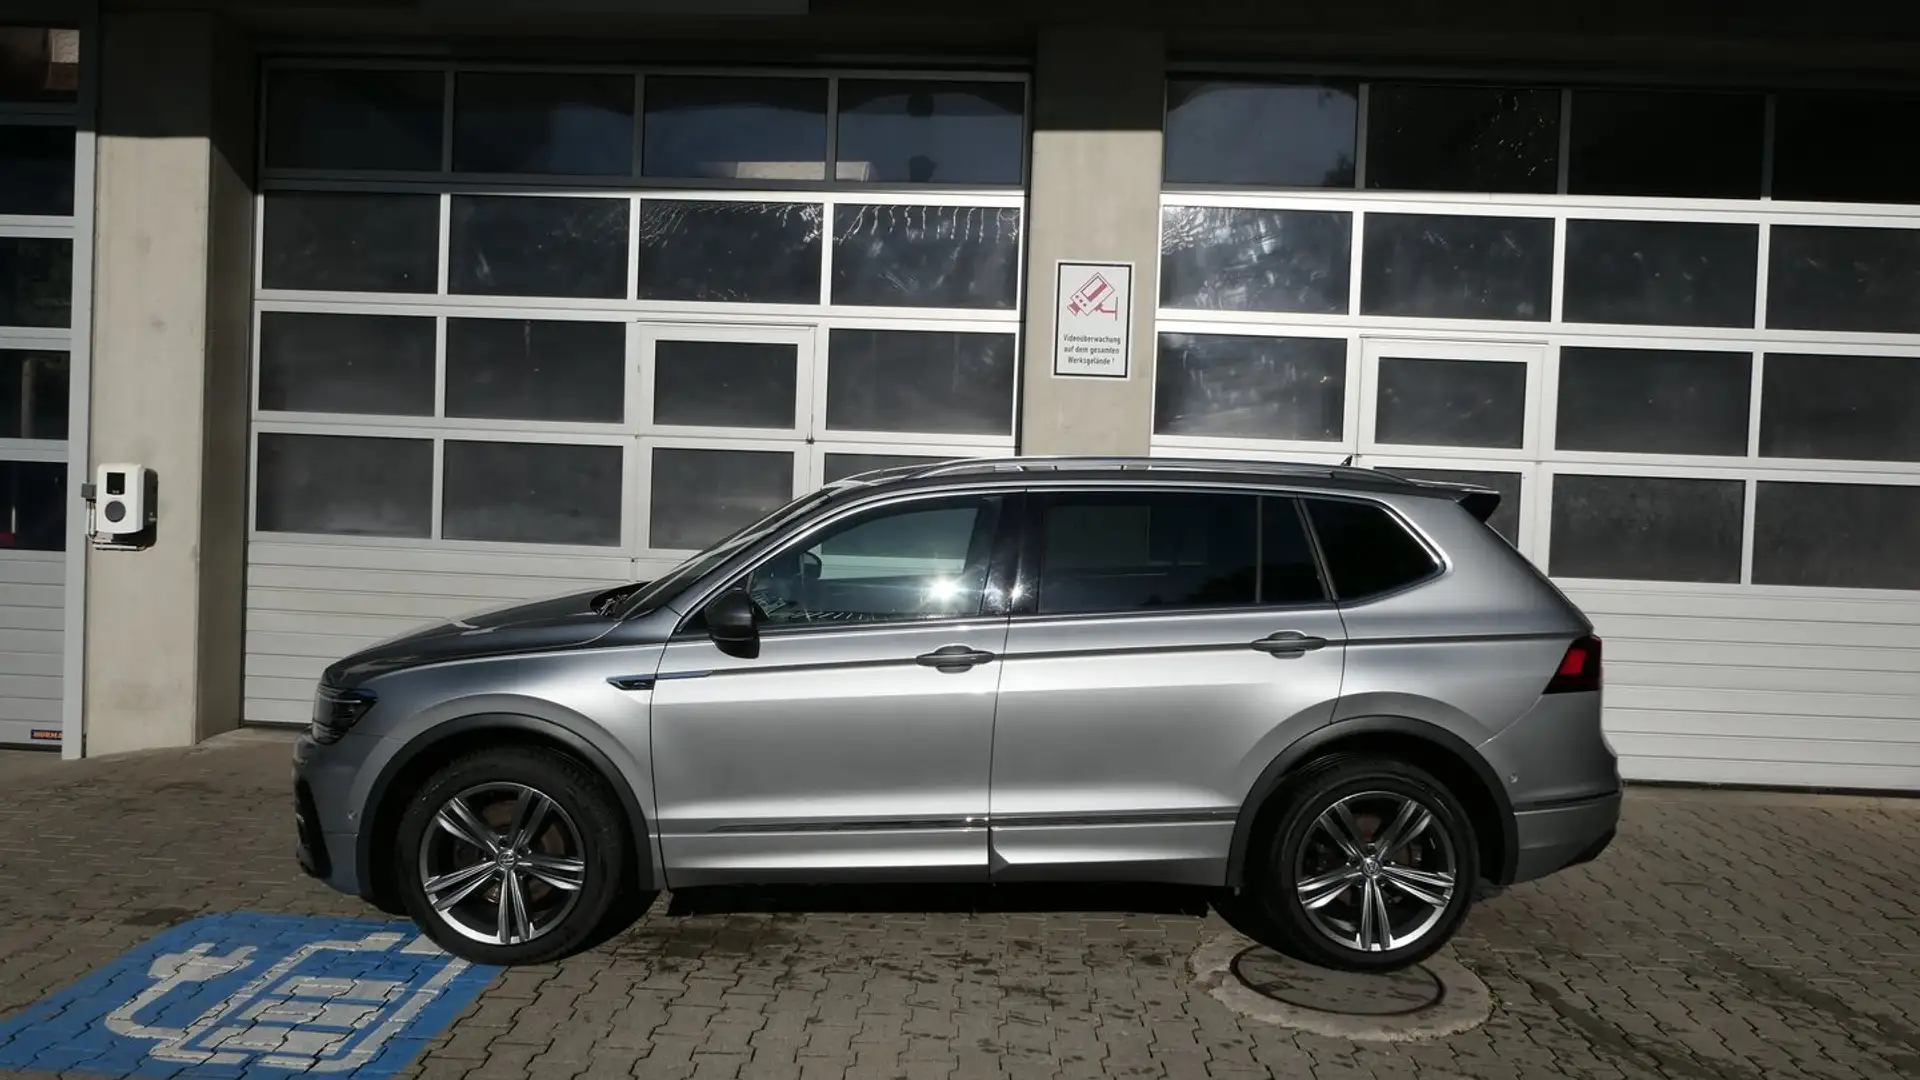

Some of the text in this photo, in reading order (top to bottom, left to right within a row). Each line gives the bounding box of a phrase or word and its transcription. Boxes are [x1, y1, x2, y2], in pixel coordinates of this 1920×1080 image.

[1063, 333, 1121, 345] Videoüberwachung
[1063, 345, 1120, 355] auf dem gesamten
